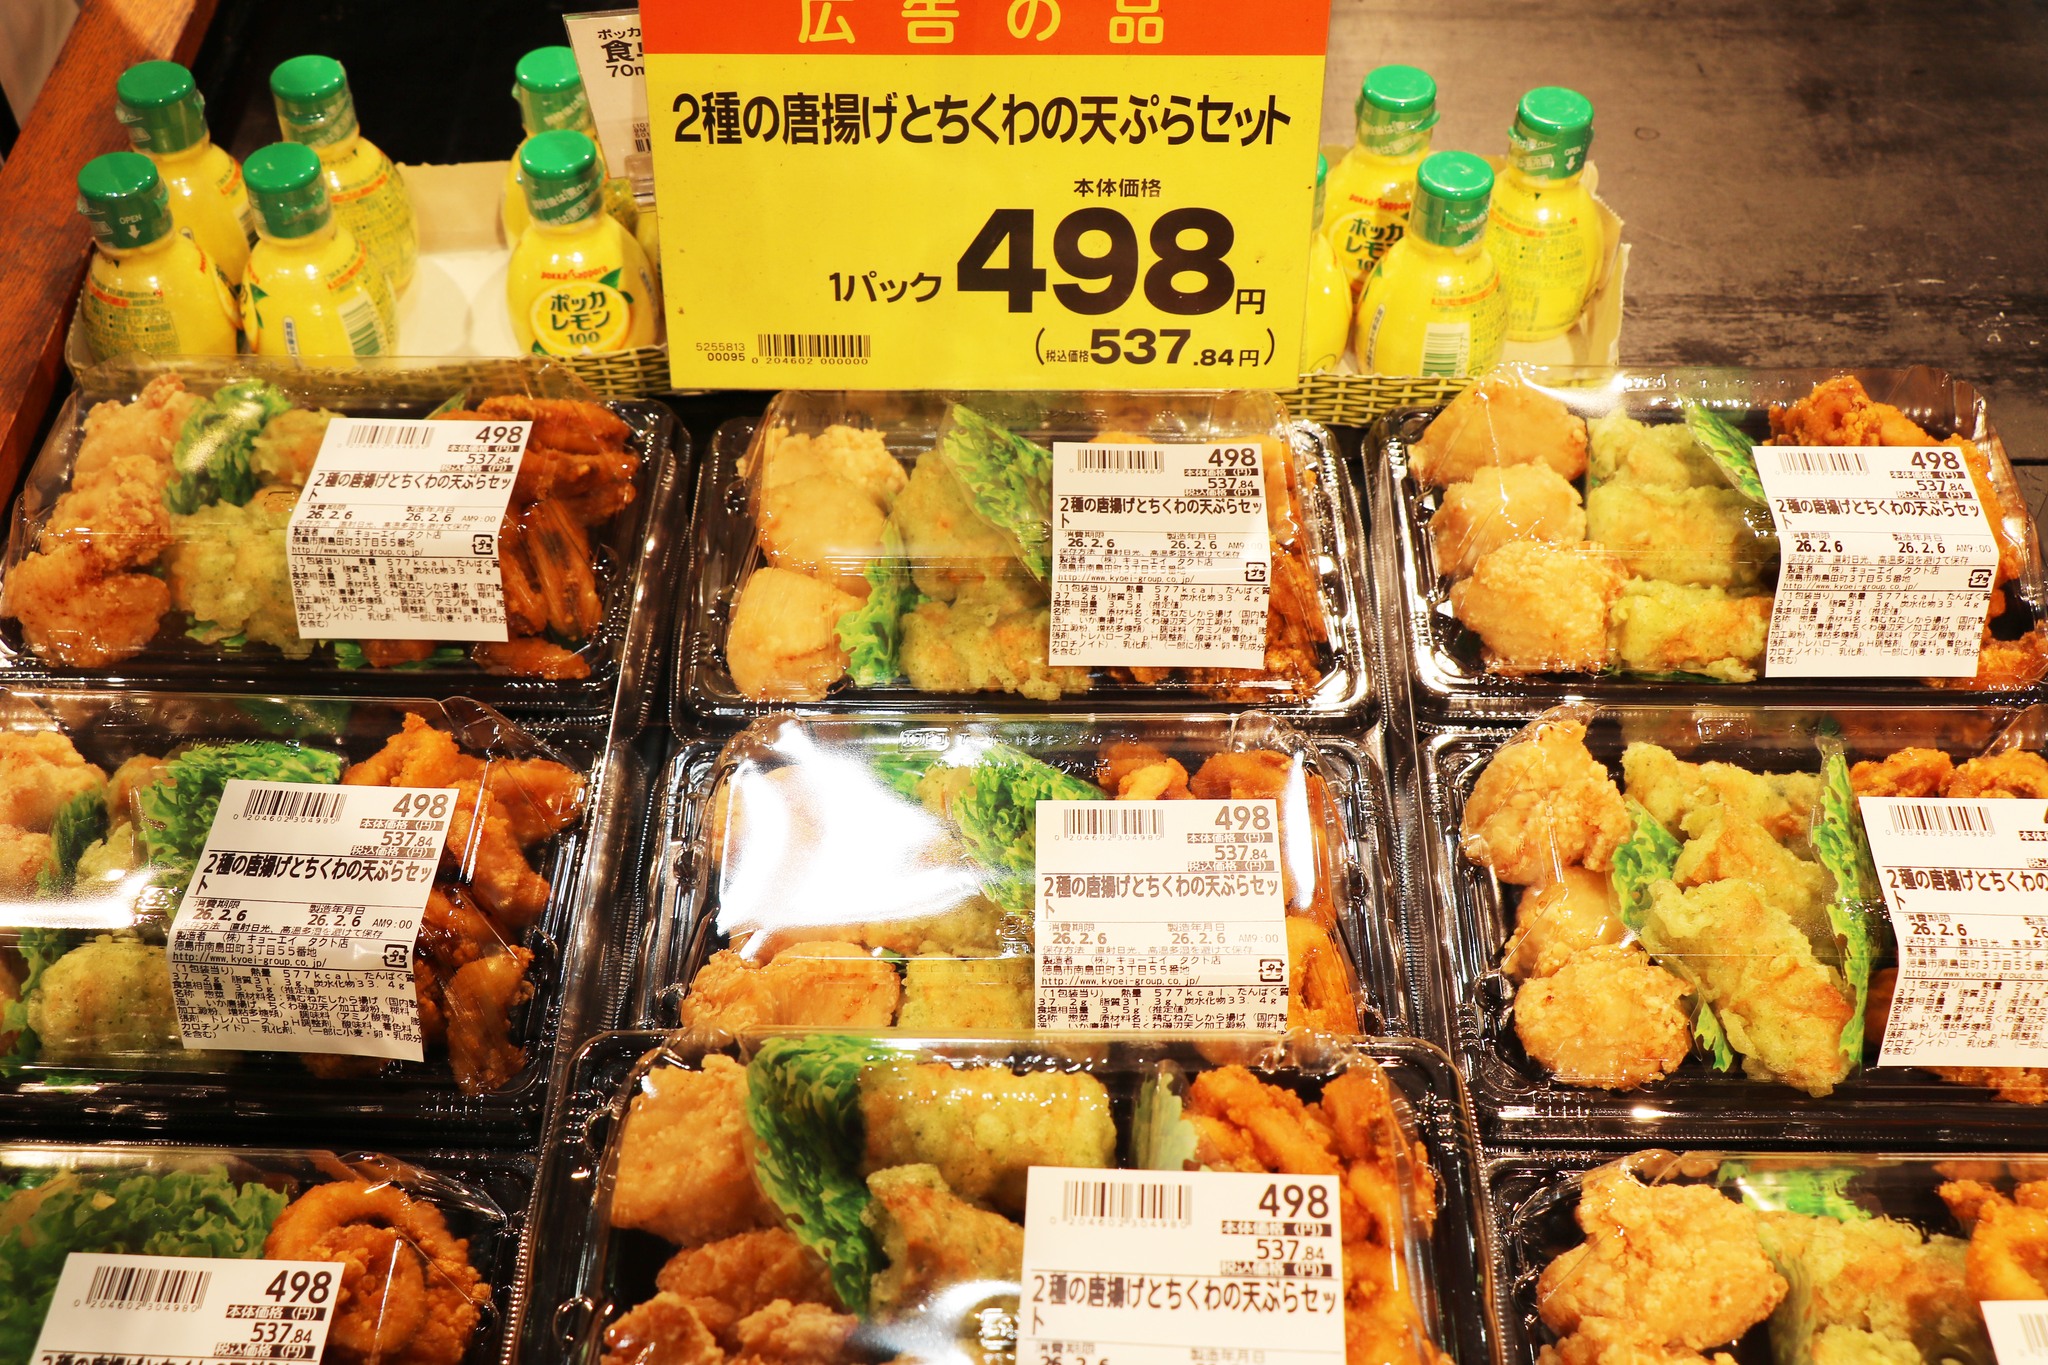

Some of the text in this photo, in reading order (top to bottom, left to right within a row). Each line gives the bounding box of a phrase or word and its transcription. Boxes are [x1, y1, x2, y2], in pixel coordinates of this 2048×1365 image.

[798, 0, 1164, 44] 広告の品
[672, 91, 1291, 146] 2種の唐揚げとちくわの天ぷらセット
[1073, 178, 1162, 198] 本体価格
[119, 214, 143, 225] OPEN
[1348, 217, 1405, 242] ポッカ
[829, 270, 943, 303] 1パック
[550, 291, 607, 313] ポッカ
[551, 310, 610, 331] レモン
[567, 331, 600, 345] 100
[696, 343, 746, 352] 5255813
[707, 352, 746, 362] 00095
[475, 426, 523, 444] 498
[466, 453, 511, 464] 537.84
[1208, 447, 1257, 467] 498
[1911, 451, 1960, 470] 498
[1208, 477, 1254, 489] 537.84
[1916, 480, 1965, 491] 537.84
[306, 510, 353, 520] 26.2.6
[405, 512, 451, 522] 26.2.6
[1067, 538, 1217, 550] 26.2.6 26.2.6
[1795, 539, 1843, 553] 26.2.6
[1897, 542, 1946, 554] 26.2.6
[392, 793, 449, 819] 498
[1214, 805, 1271, 831] 498
[381, 831, 433, 847] 537.84
[1214, 844, 1268, 861] 537.84
[203, 852, 433, 883] 2種の唐揚げとちくわの天ぷらセッ
[195, 874, 208, 895] ト
[1043, 874, 1278, 898] 2種の唐揚げとちくわの天ぷらセッ
[193, 899, 366, 915] 消費期限 製造年月日
[1045, 898, 1055, 920] ト
[192, 908, 413, 929] 26.2.6 26.2.6 AM9:00
[1049, 923, 1095, 932] 消費期限
[1052, 932, 1280, 945] 26.2.6 26.2.6 AM9:00
[1911, 922, 1967, 936] 26.2.6
[175, 931, 206, 941] 製造者
[308, 937, 349, 949] タクト店
[1258, 1184, 1329, 1219] 498
[1257, 1238, 1325, 1261] 537.84
[265, 1270, 332, 1304] 498
[1032, 1306, 1044, 1336] ト
[250, 1322, 313, 1343] 537.84
